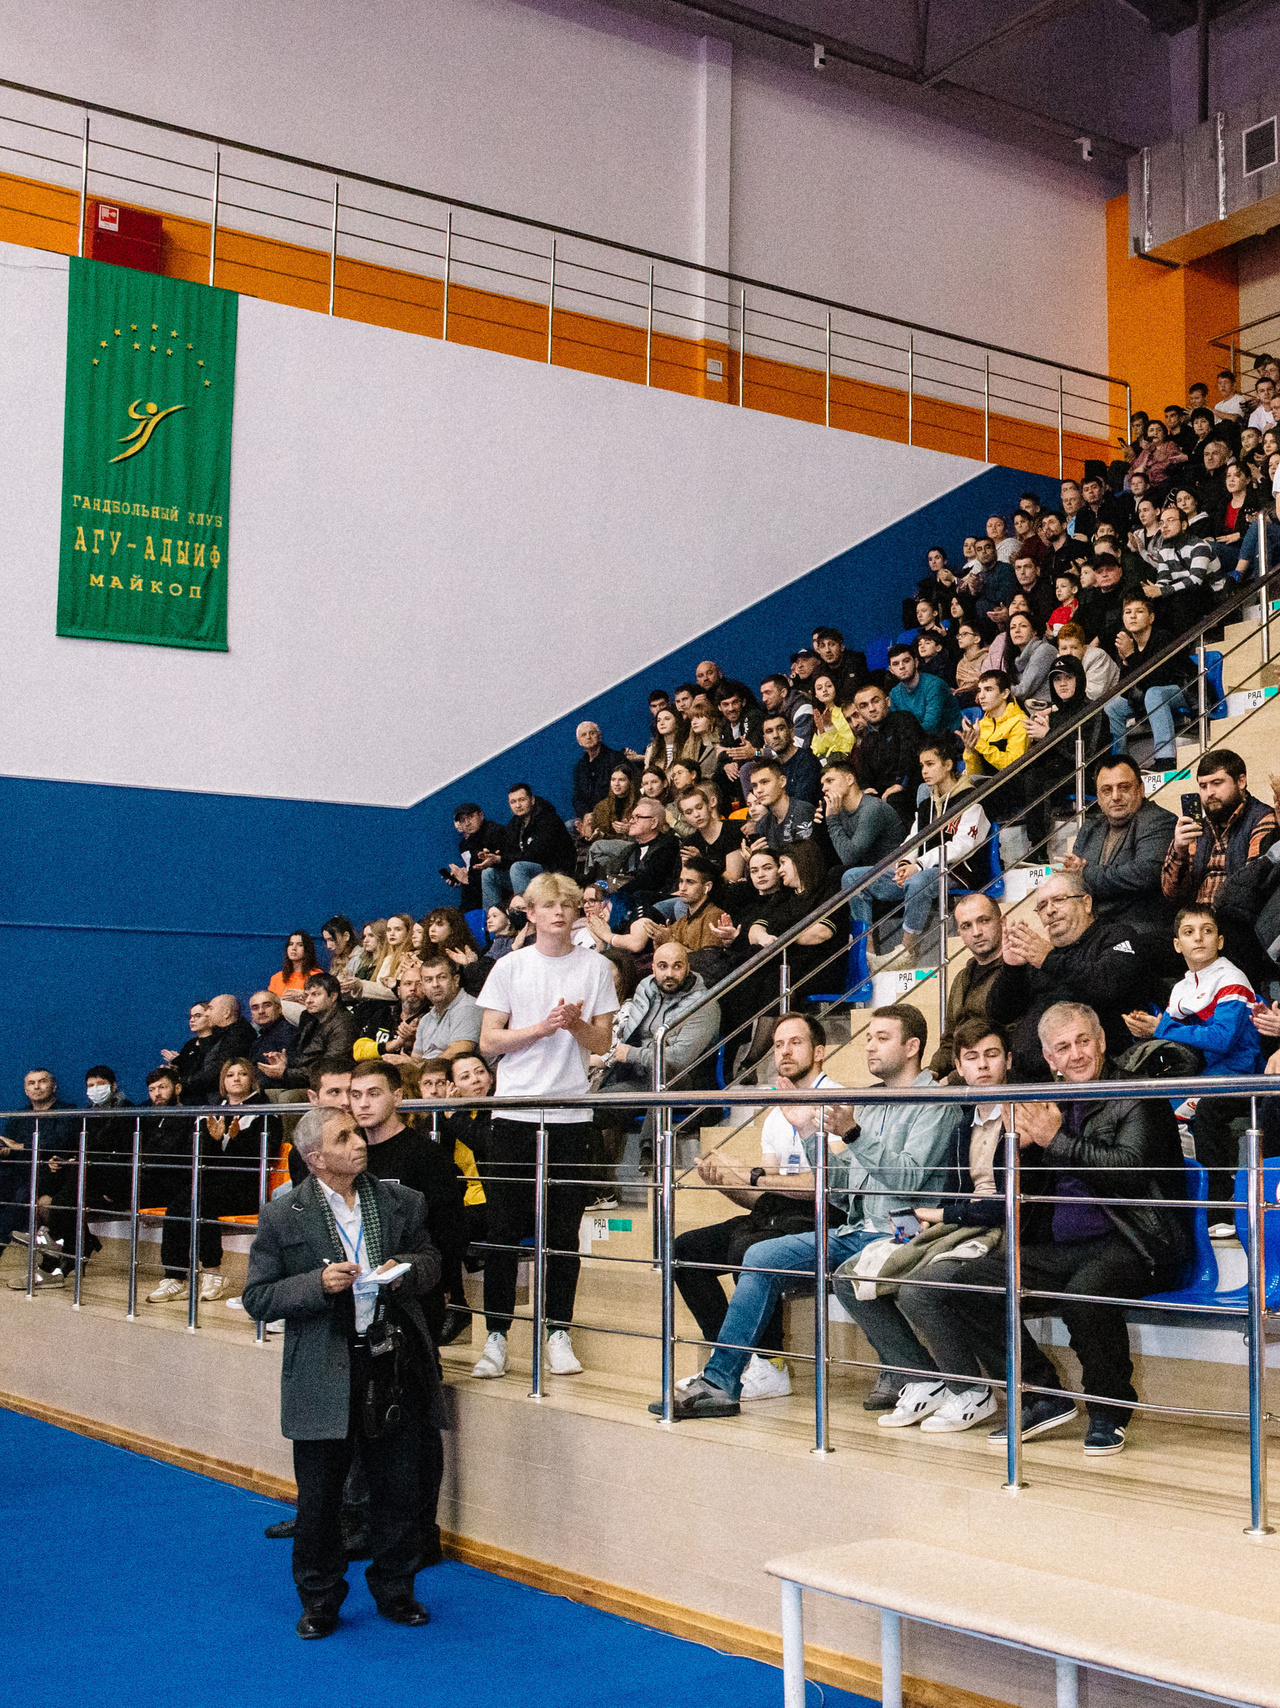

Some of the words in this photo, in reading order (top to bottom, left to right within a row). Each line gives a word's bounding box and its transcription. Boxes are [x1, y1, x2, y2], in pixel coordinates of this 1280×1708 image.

[73, 494, 179, 522] ГАНДБОЛЬНЫЙ
[188, 511, 223, 528] КЛУБ
[74, 526, 221, 569] АГУ-АДЫИФ
[89, 573, 202, 599] МАЙКОП
[1247, 690, 1262, 699] РЯД
[1147, 774, 1162, 784] РЯД
[1152, 783, 1157, 791] 5
[1029, 868, 1043, 878] РЯД
[898, 972, 913, 982] РЯД
[904, 982, 908, 991] 3
[593, 1218, 607, 1229] РЯД
[598, 1229, 603, 1239] 1
